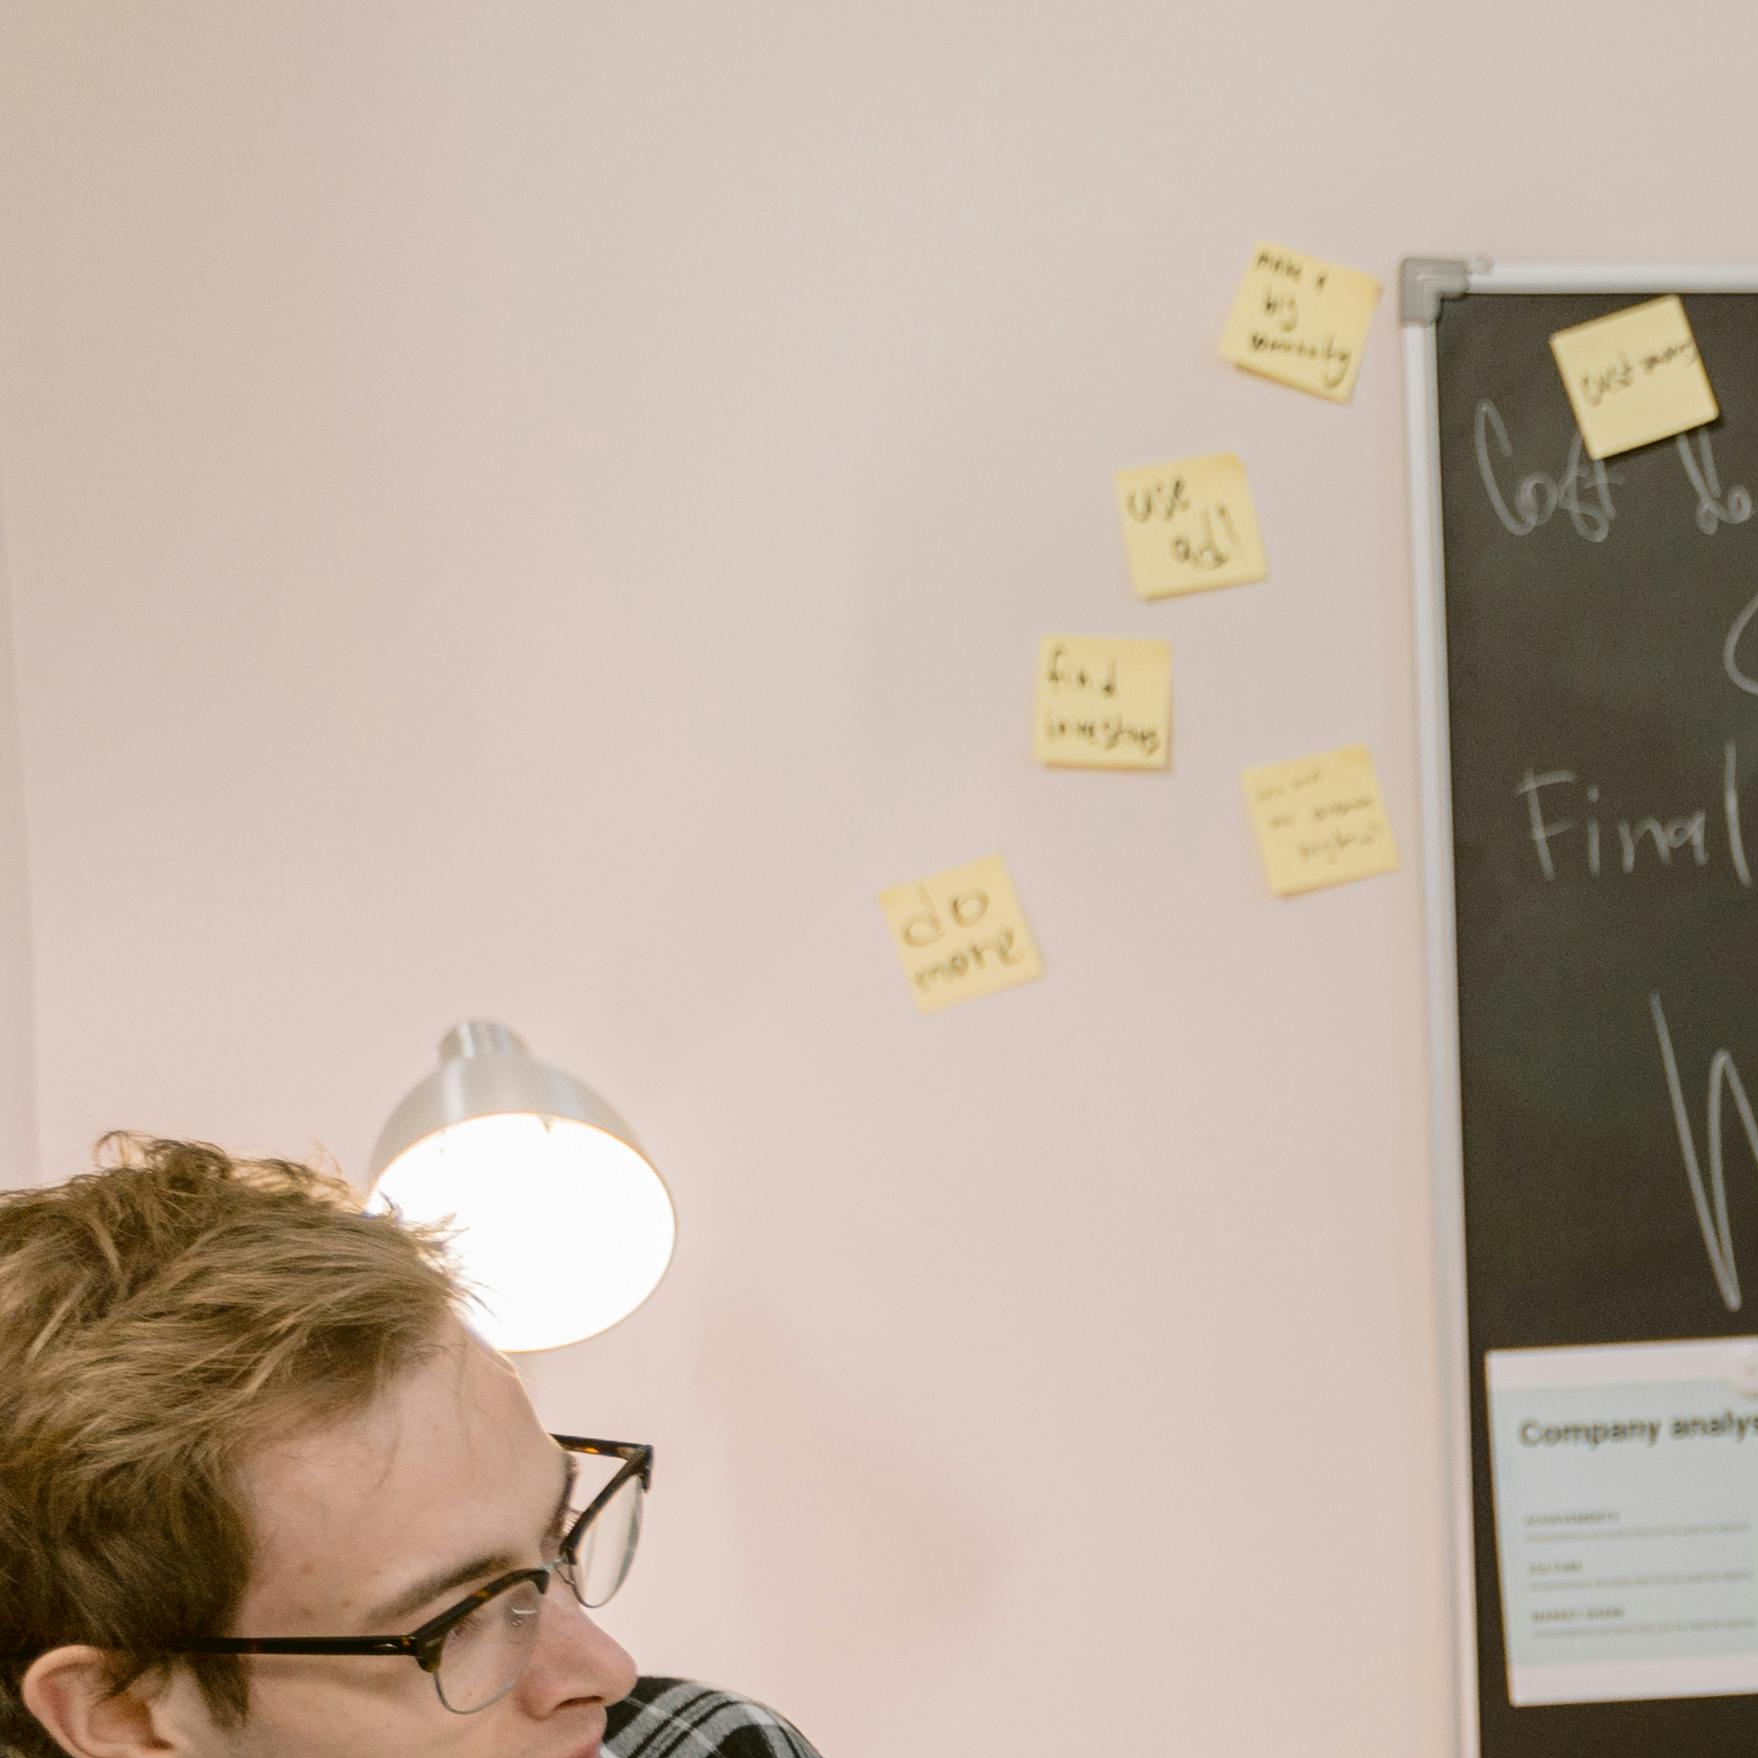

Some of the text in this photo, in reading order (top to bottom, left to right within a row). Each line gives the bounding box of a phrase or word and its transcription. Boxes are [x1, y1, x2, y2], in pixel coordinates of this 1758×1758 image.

[1515, 738, 1754, 889] Final
[912, 926, 1028, 995] more
[1518, 1416, 1662, 1449] Company
